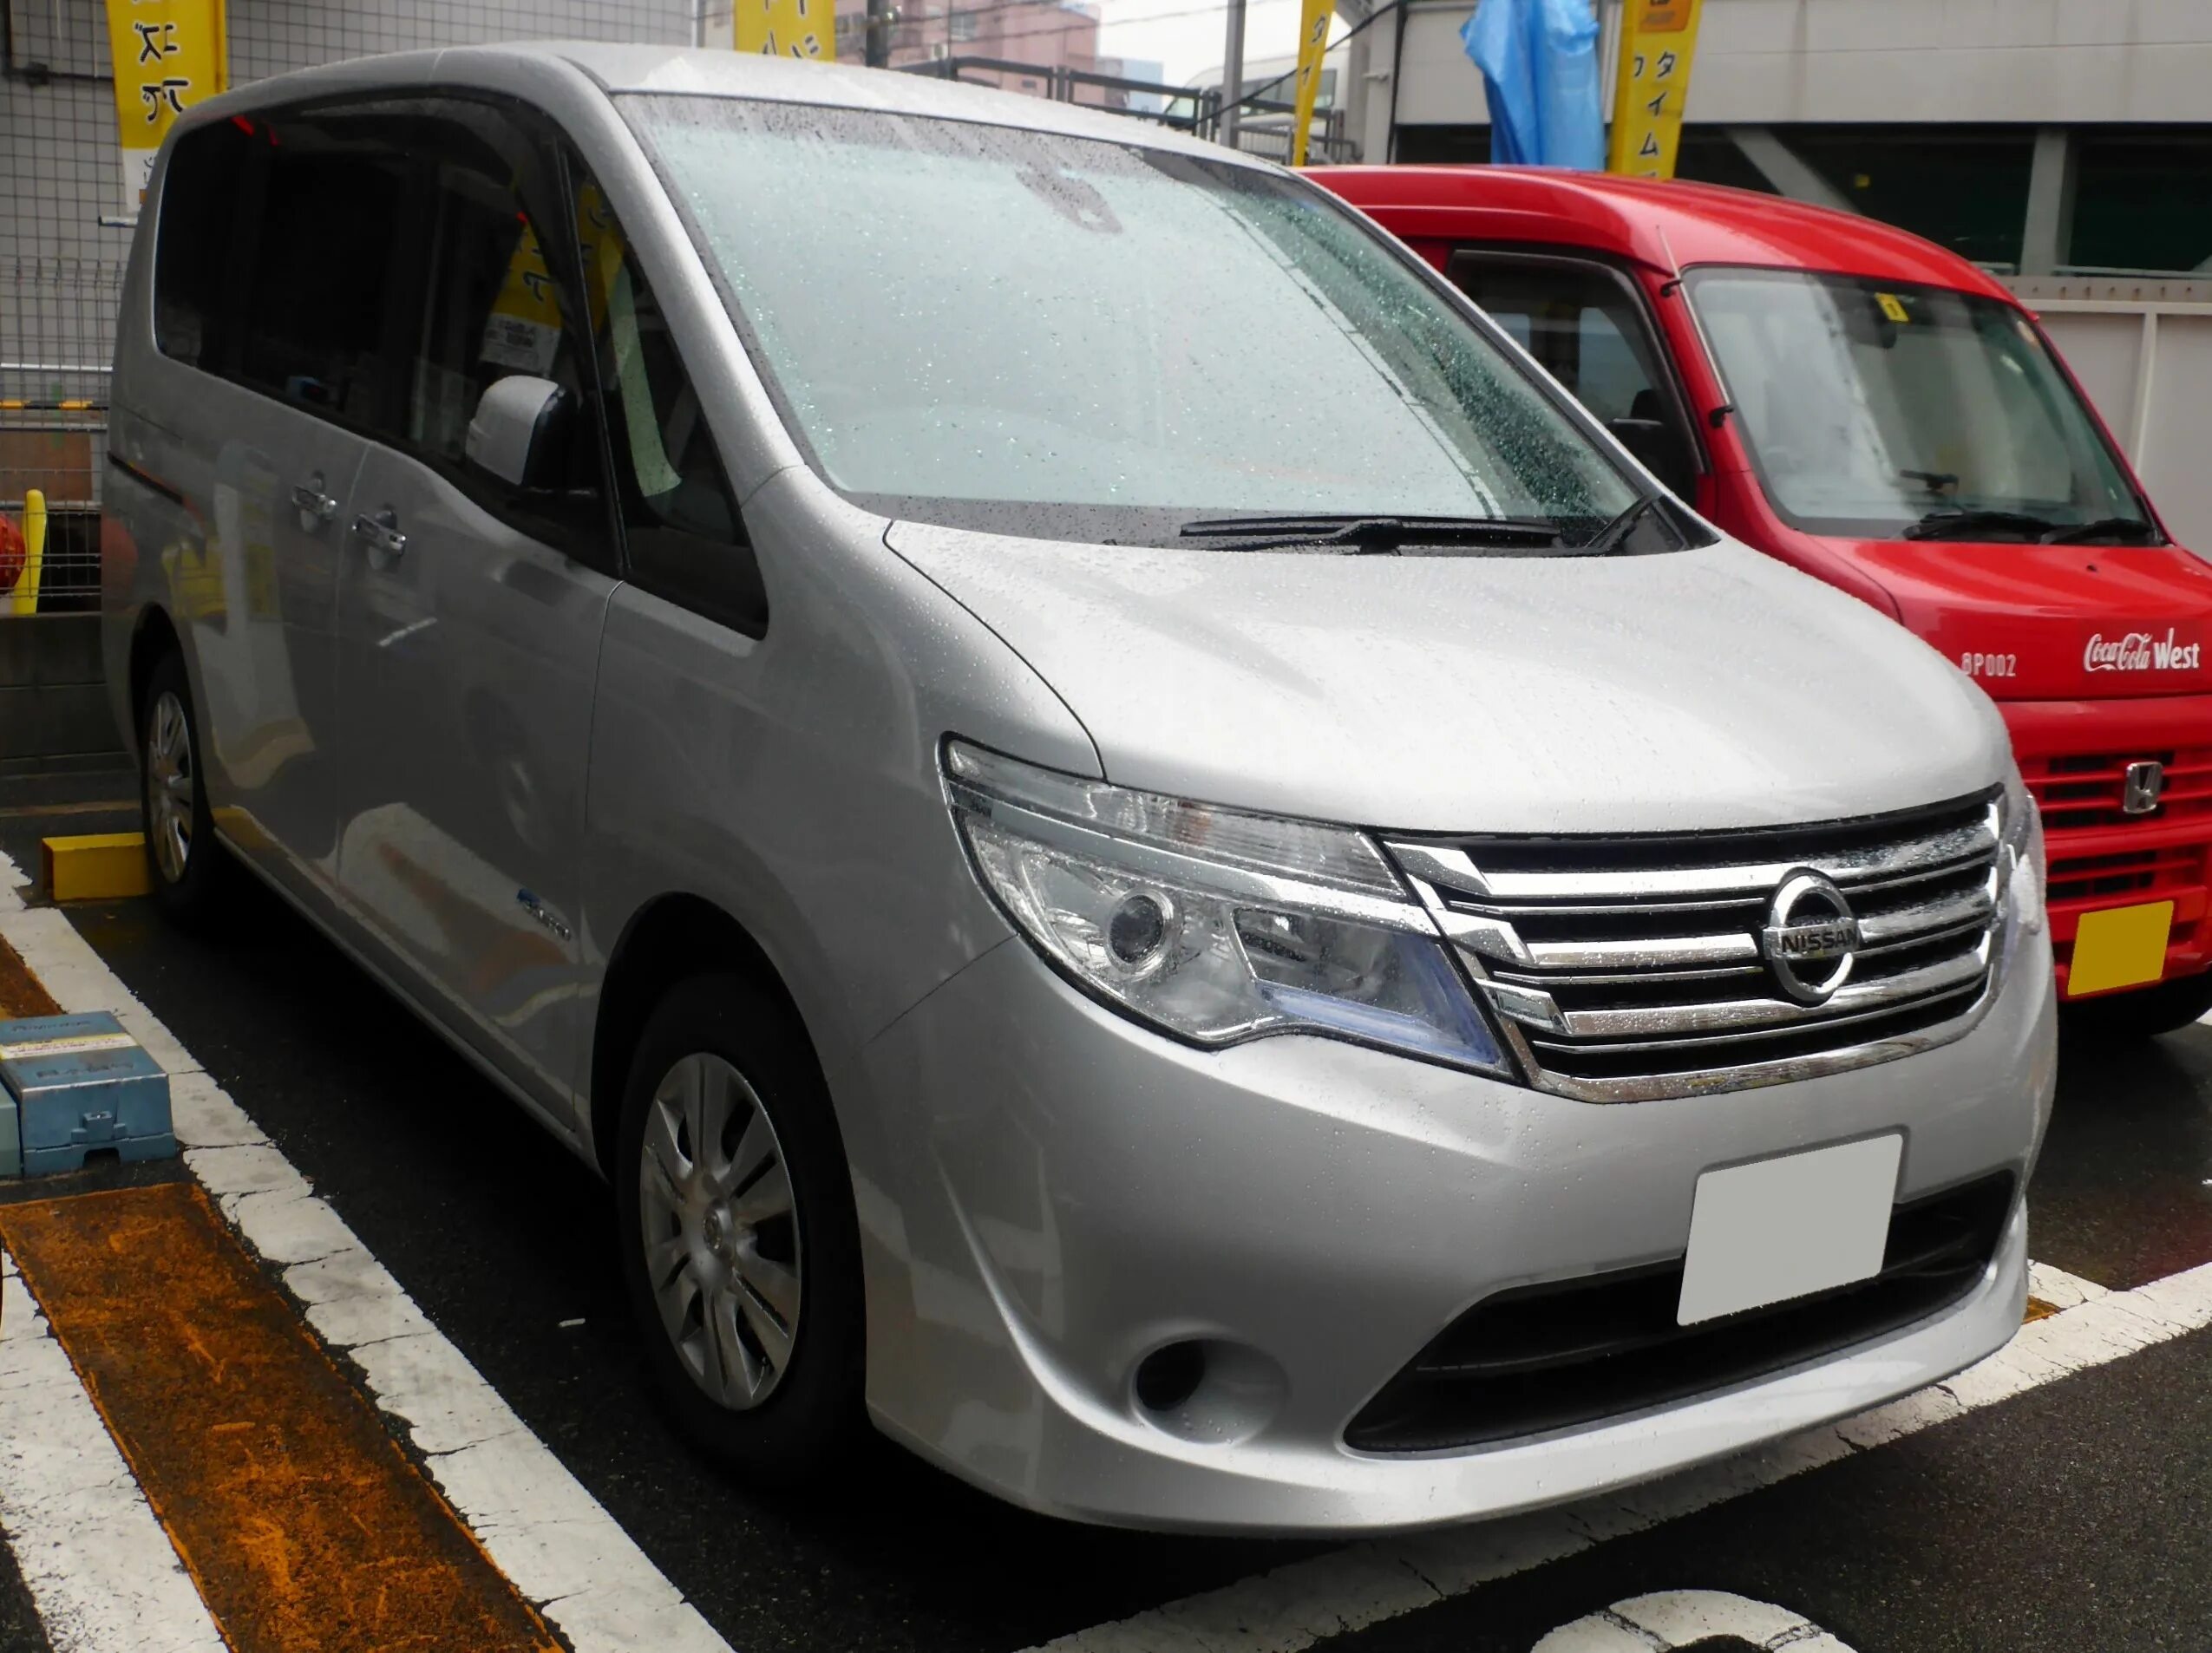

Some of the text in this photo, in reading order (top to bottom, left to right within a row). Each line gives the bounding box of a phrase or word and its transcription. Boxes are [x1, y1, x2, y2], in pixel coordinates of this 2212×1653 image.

[1639, 50, 1676, 177] タイム
[2153, 627, 2201, 670] West
[1781, 927, 1857, 954] NISSAN
